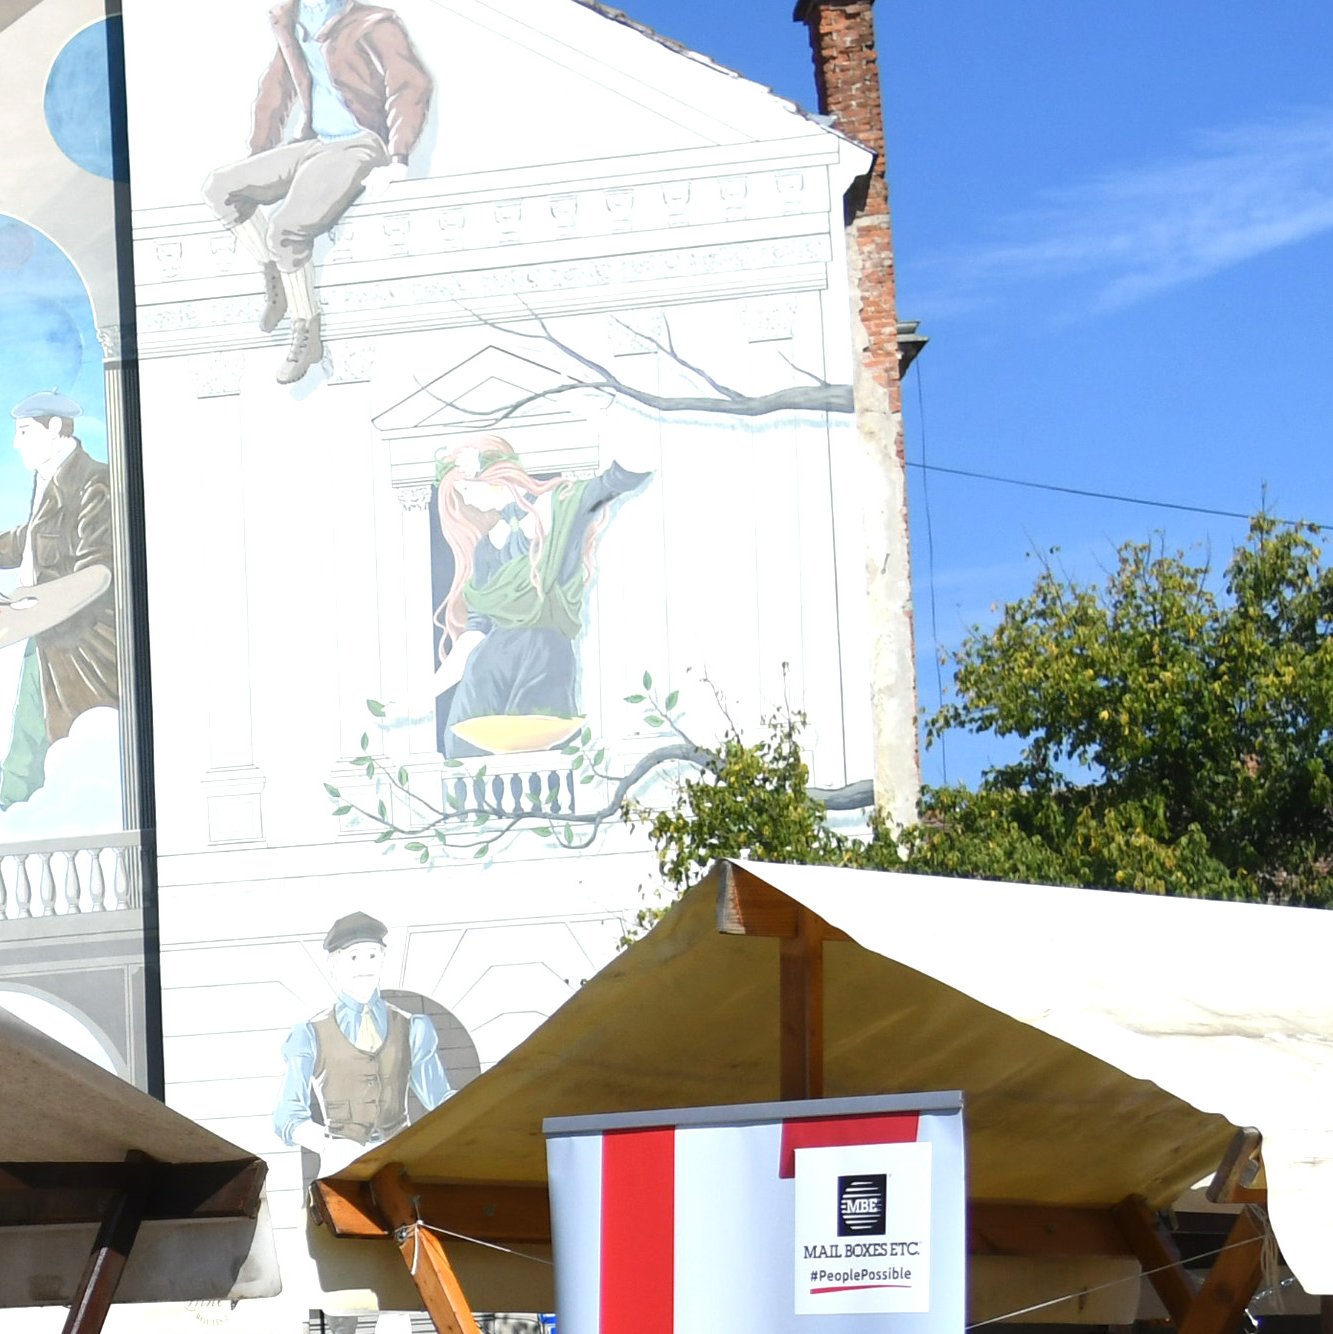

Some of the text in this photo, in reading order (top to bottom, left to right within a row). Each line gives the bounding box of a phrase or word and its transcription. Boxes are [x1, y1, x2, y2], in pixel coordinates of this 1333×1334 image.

[846, 1198, 878, 1214] MBE
[803, 1241, 920, 1260] MAIL BOXES ETC.
[810, 1266, 912, 1283] #PeoplePossible
